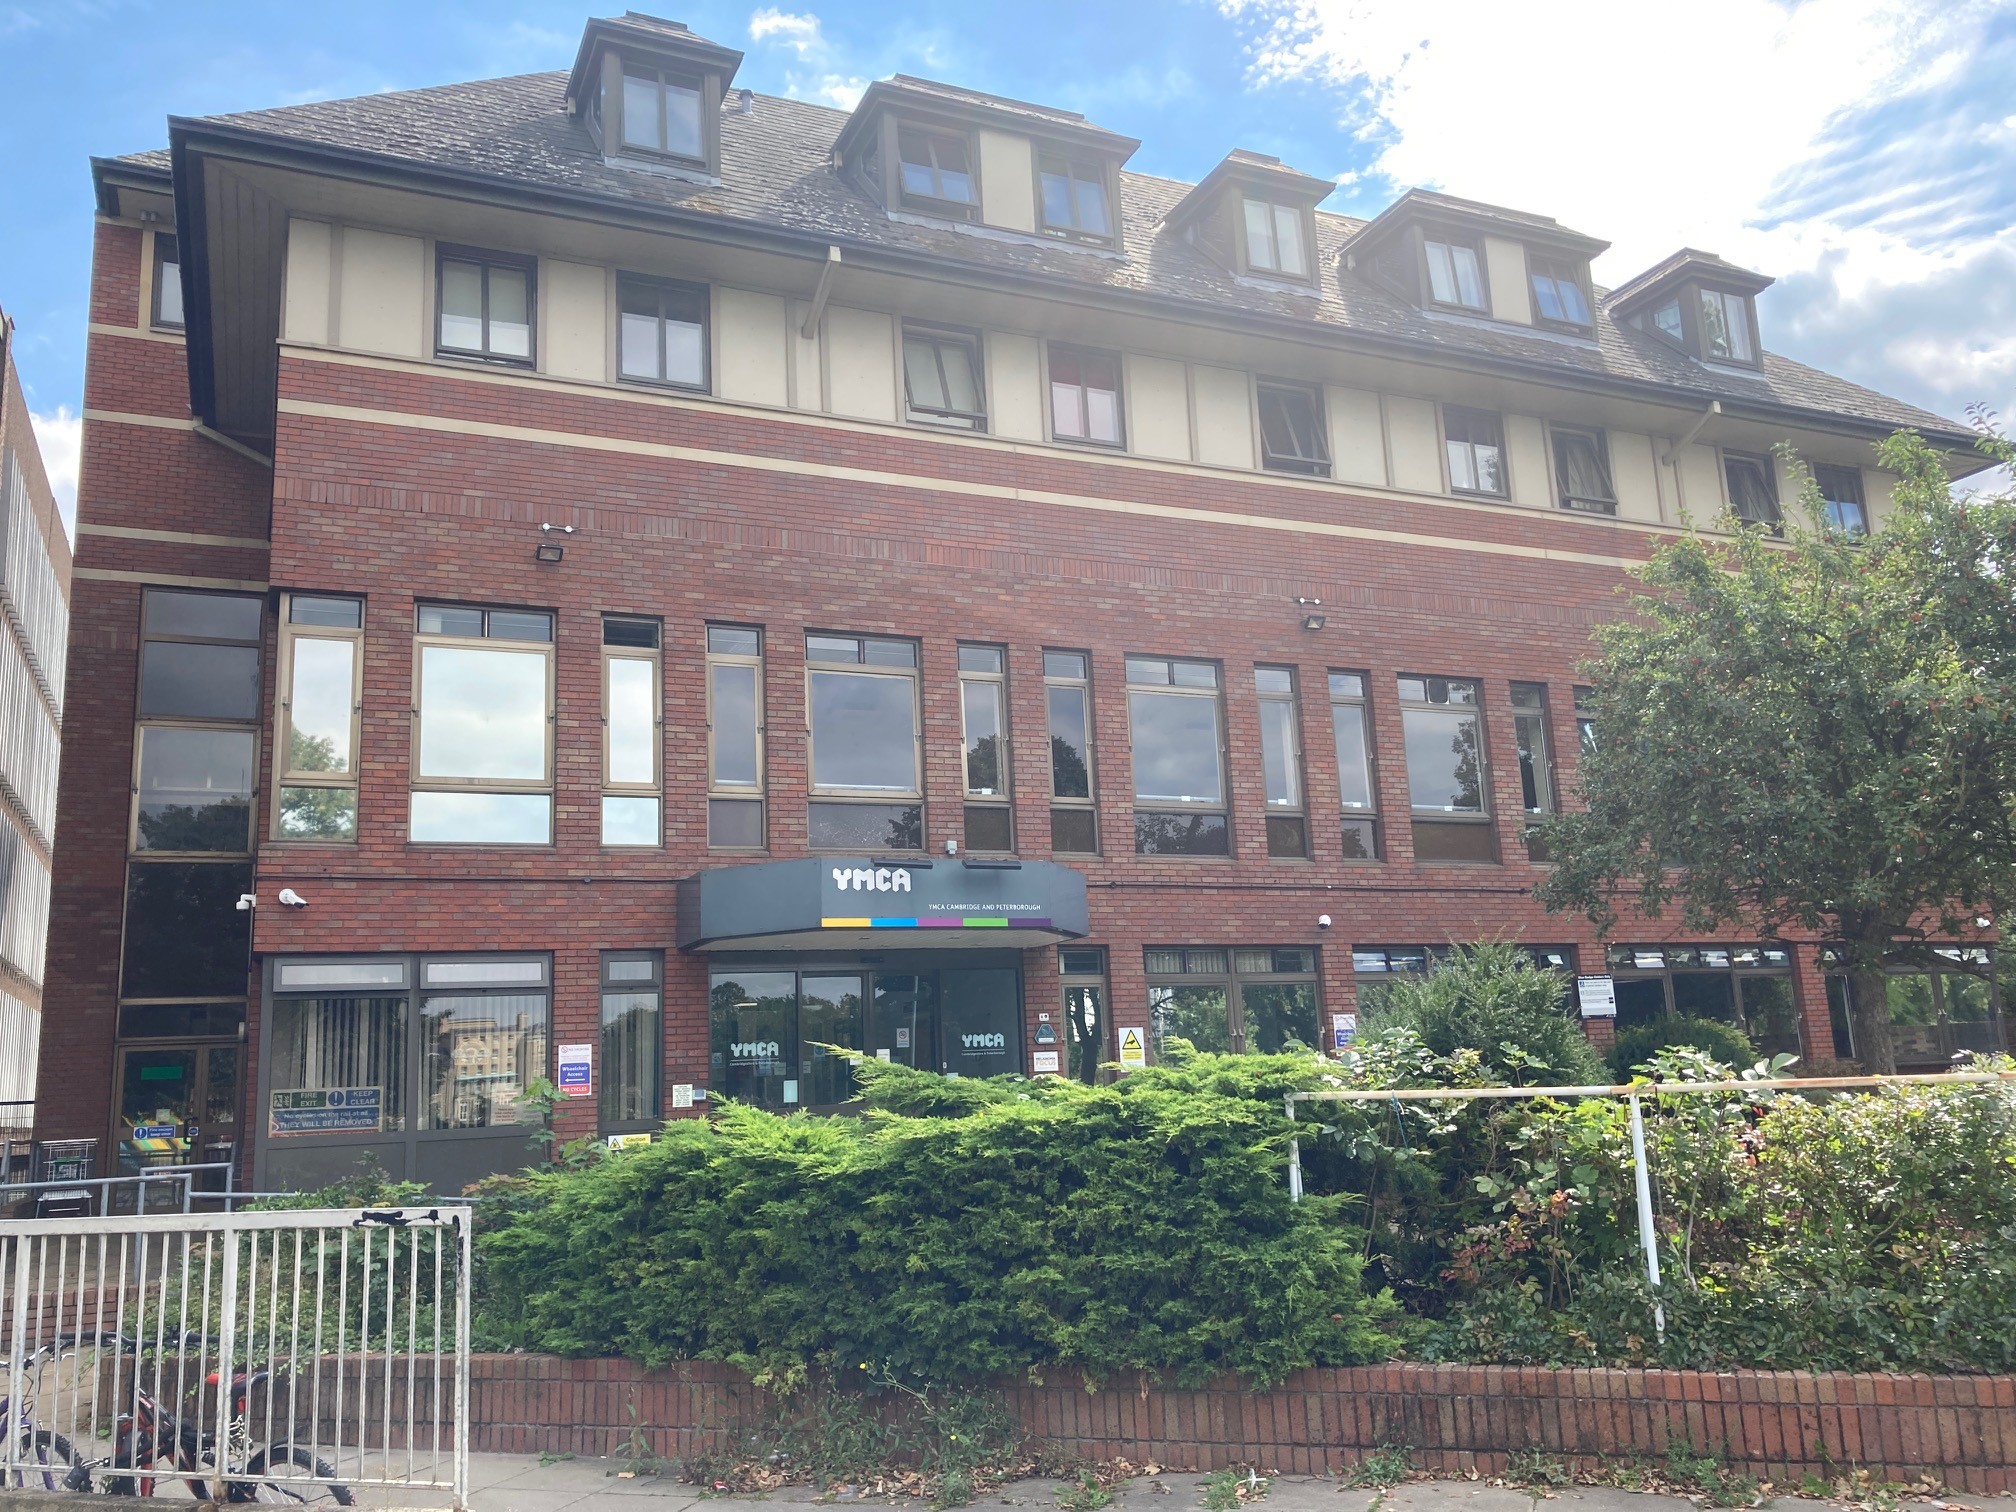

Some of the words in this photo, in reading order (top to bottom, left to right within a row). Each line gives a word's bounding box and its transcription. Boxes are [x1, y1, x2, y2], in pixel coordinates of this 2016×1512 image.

[832, 867, 912, 892] YMCA
[962, 1033, 1004, 1047] YMCA
[730, 1041, 779, 1057] YMCA
[302, 1120, 321, 1128] WILL
[335, 1118, 373, 1126] REMOVED
